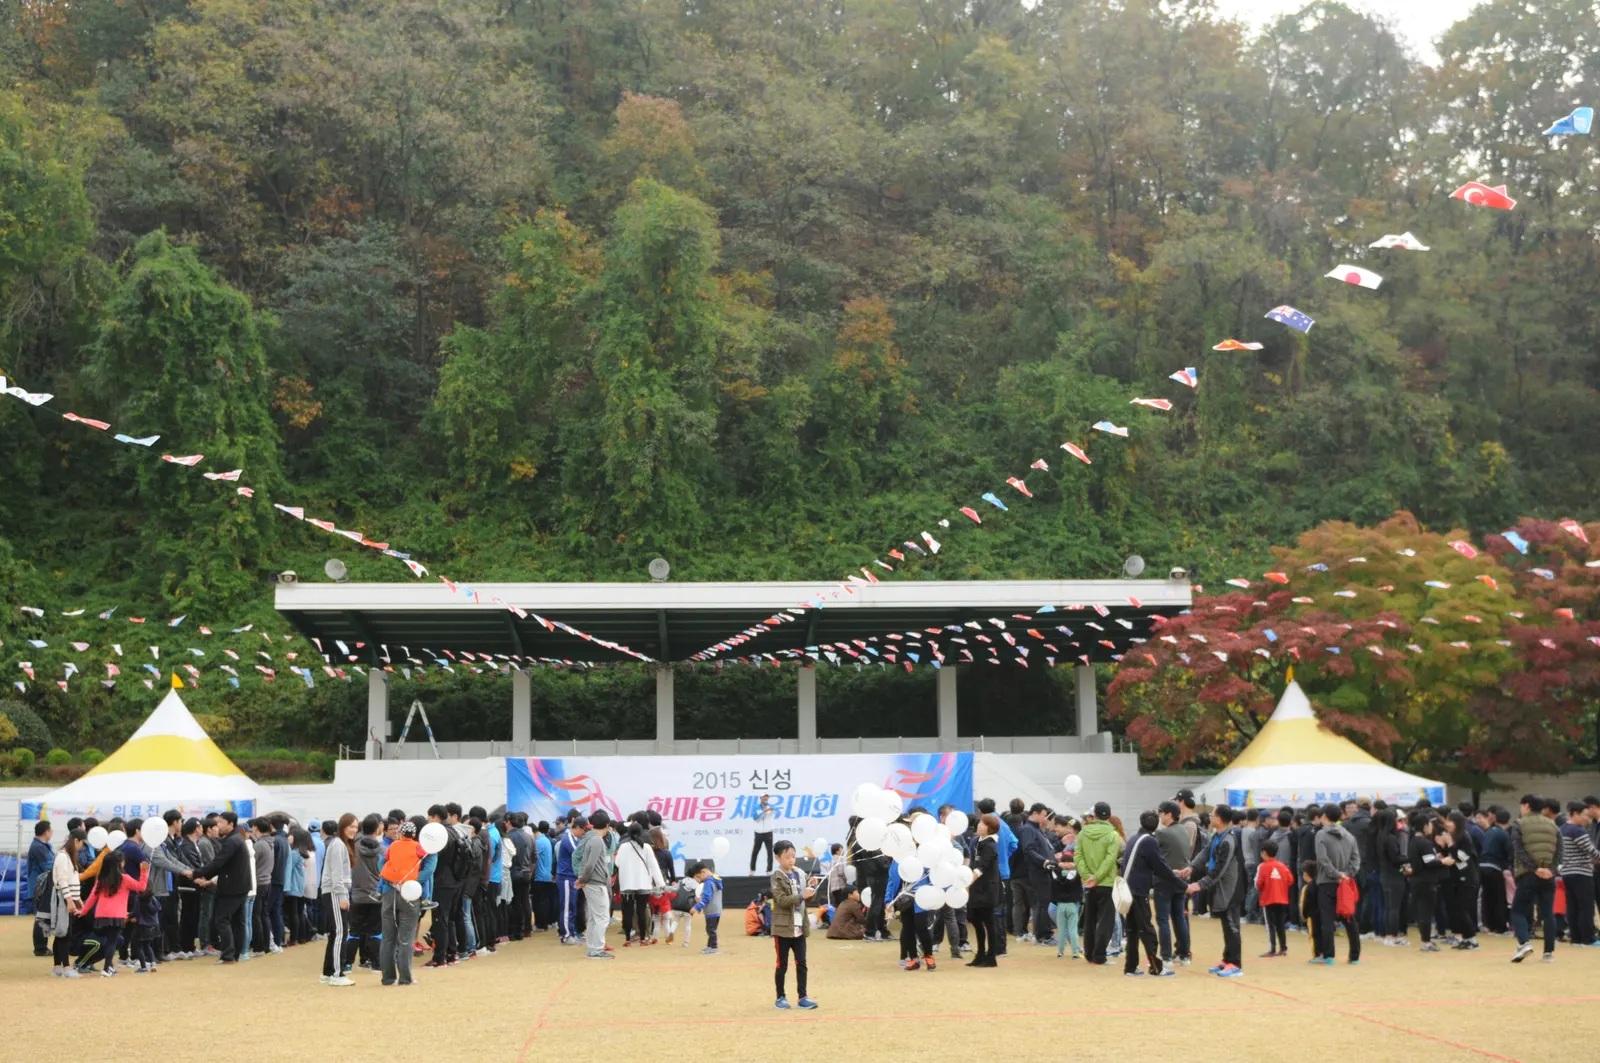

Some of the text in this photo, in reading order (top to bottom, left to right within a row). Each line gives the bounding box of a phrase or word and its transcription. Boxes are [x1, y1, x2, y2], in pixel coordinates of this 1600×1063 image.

[692, 768, 792, 791] 2015 신성
[112, 803, 160, 818] 의료진
[647, 793, 840, 822] 한마음 체육대회
